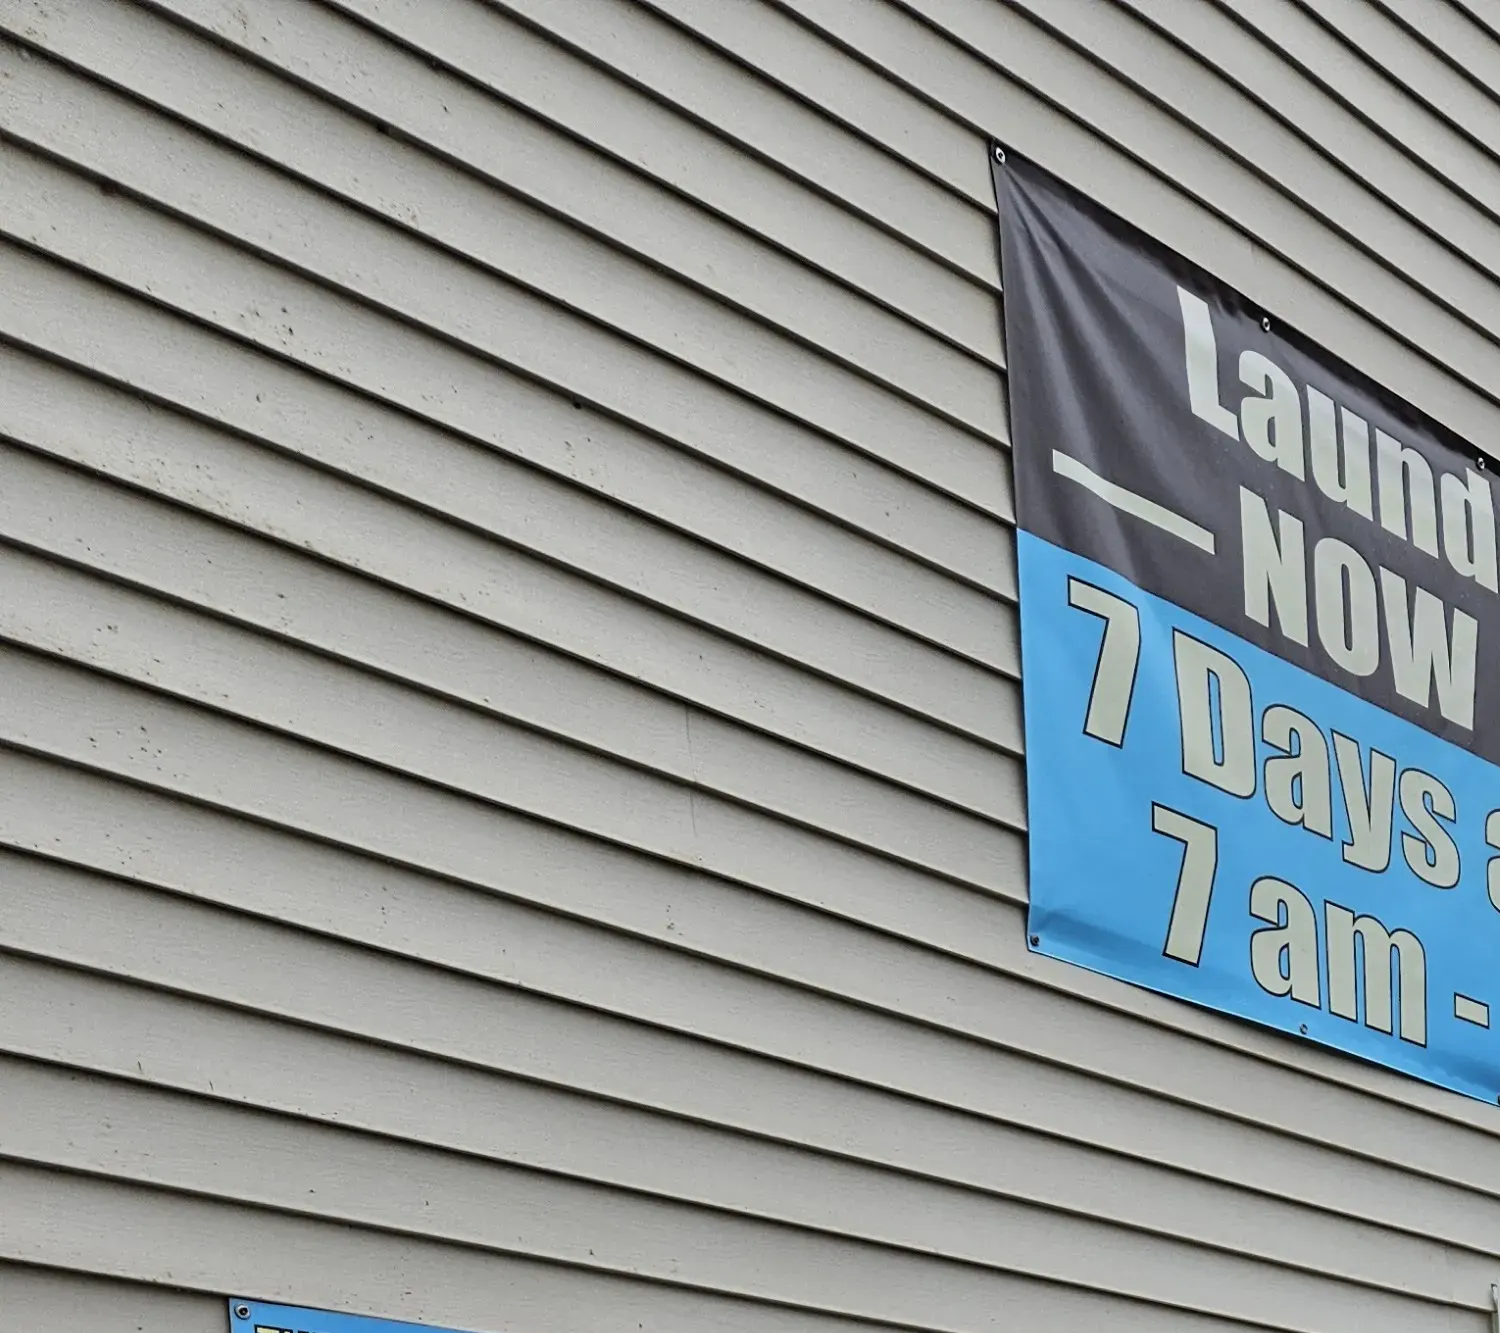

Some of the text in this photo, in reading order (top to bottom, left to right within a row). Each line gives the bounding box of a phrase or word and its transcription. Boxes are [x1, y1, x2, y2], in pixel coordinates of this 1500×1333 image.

[1067, 573, 1141, 748] 7
[1171, 626, 1462, 891] Days
[1240, 484, 1479, 732] NOW
[1151, 802, 1218, 967] 7
[1248, 875, 1428, 1048] am
